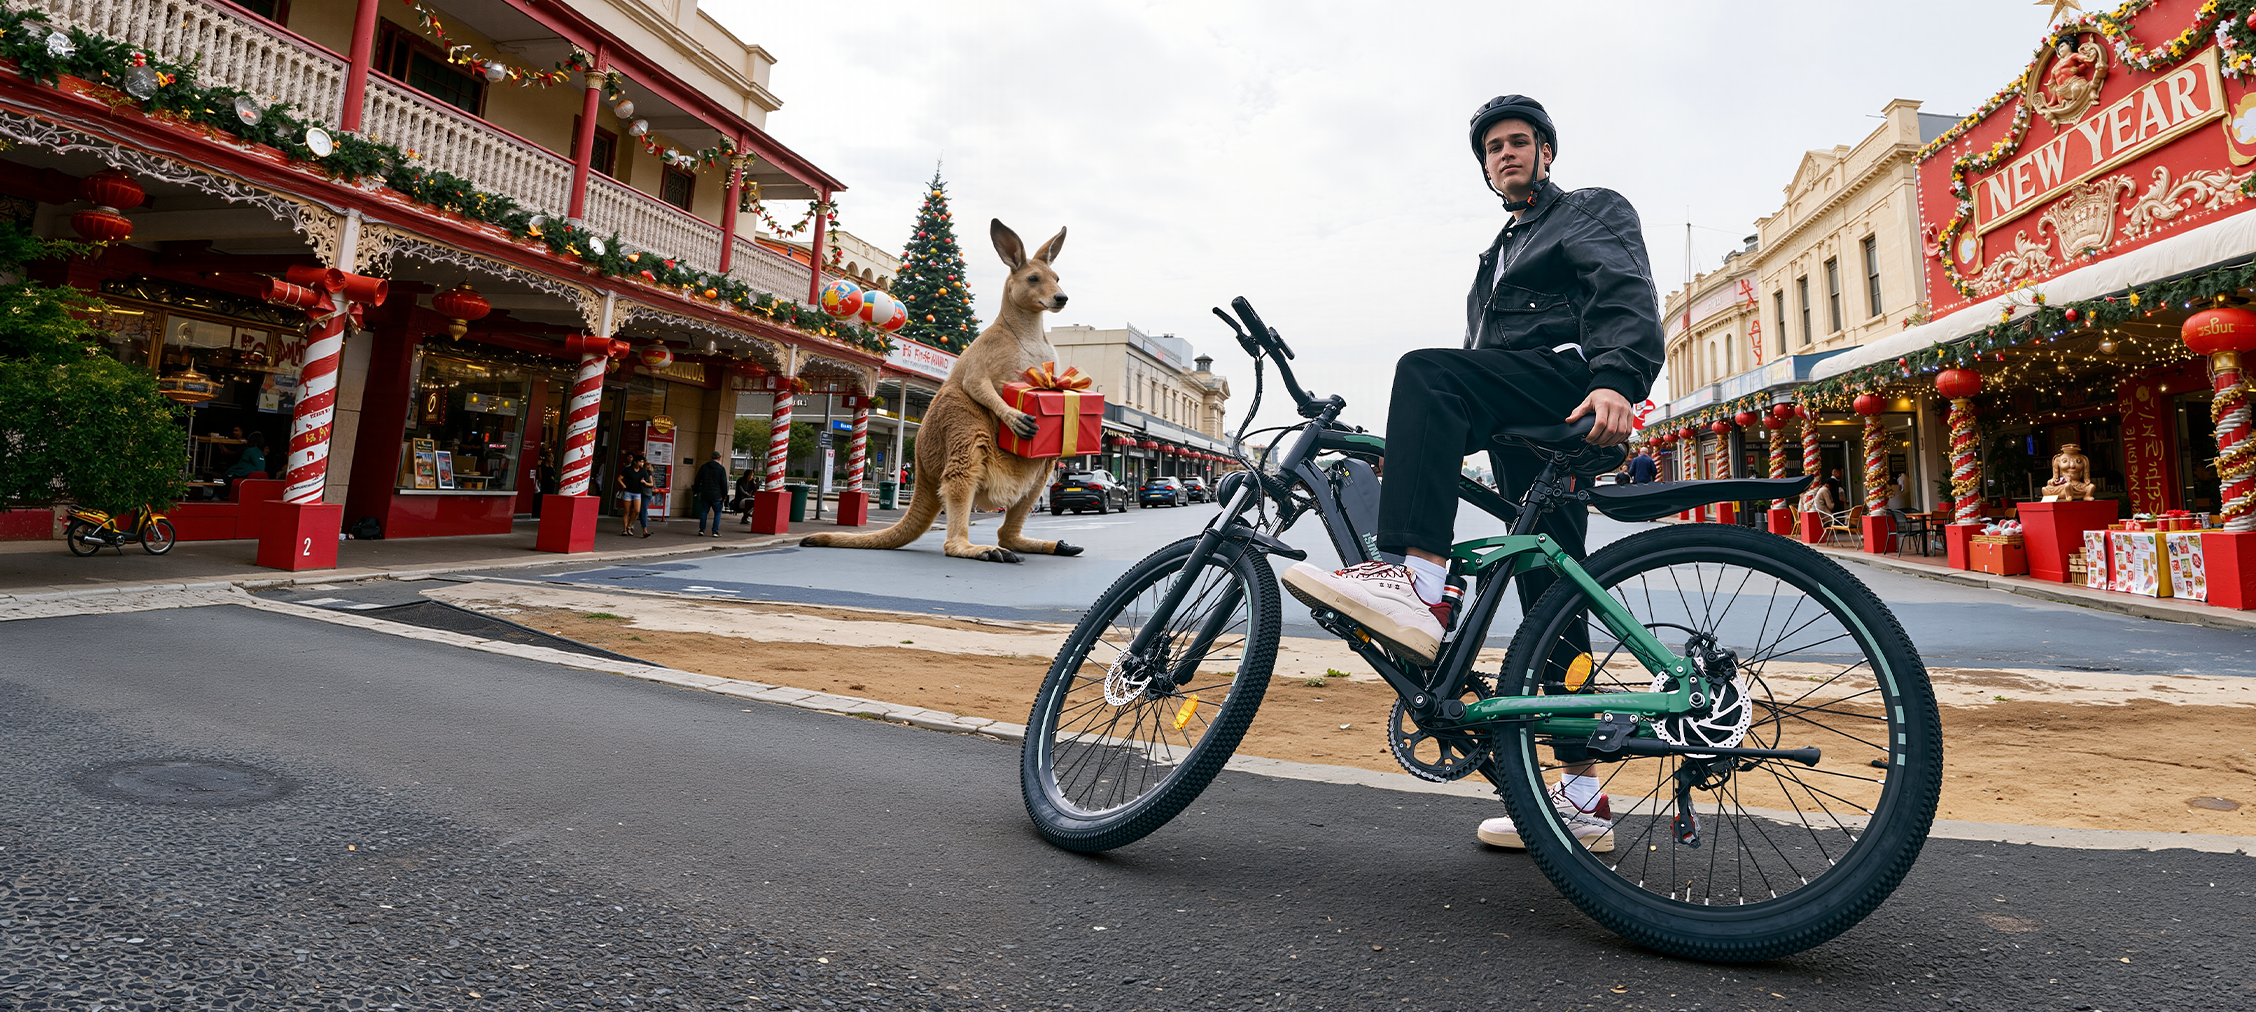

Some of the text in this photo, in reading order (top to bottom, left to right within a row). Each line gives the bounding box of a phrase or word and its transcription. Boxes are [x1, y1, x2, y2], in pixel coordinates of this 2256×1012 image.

[1986, 69, 2204, 220] NEW YEAR
[303, 537, 311, 556] 2
